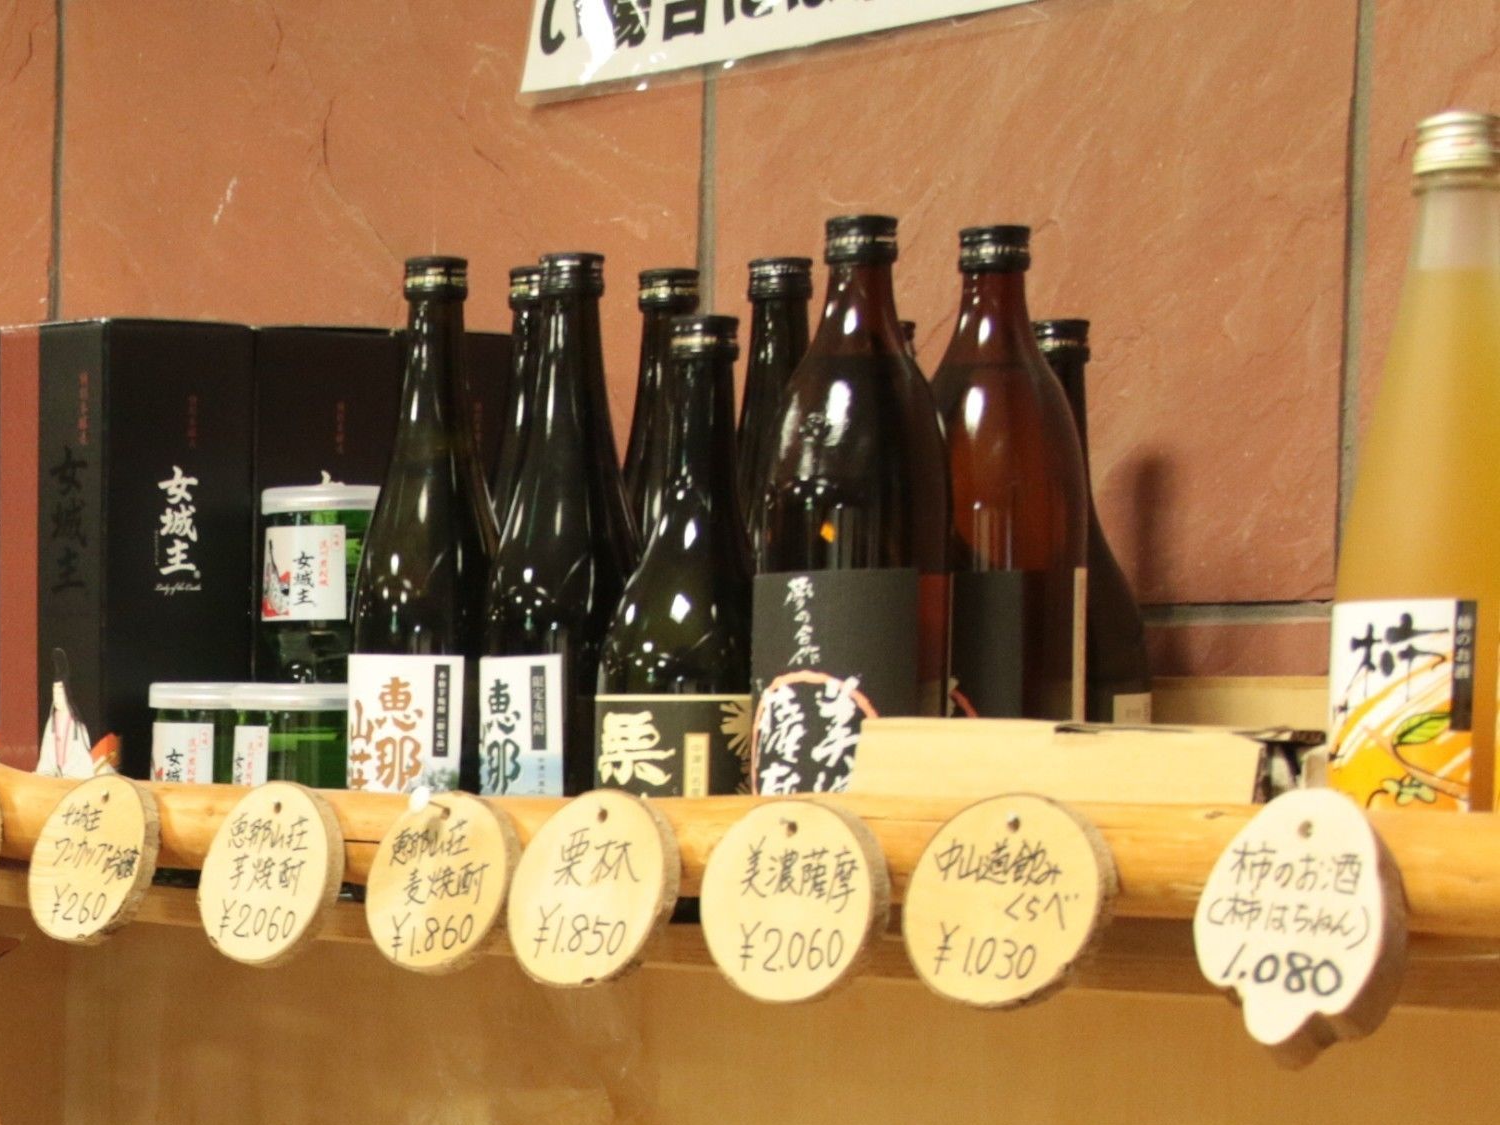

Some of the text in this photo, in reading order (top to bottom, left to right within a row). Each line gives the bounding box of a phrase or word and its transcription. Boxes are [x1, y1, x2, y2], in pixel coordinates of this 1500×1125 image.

[157, 466, 200, 577] 女城主
[293, 551, 316, 608] 女城主
[226, 811, 310, 853] 恵那山荘
[390, 820, 469, 867] 恵那山荘
[229, 857, 306, 896] 芋焼酎
[52, 884, 107, 924] ¥260
